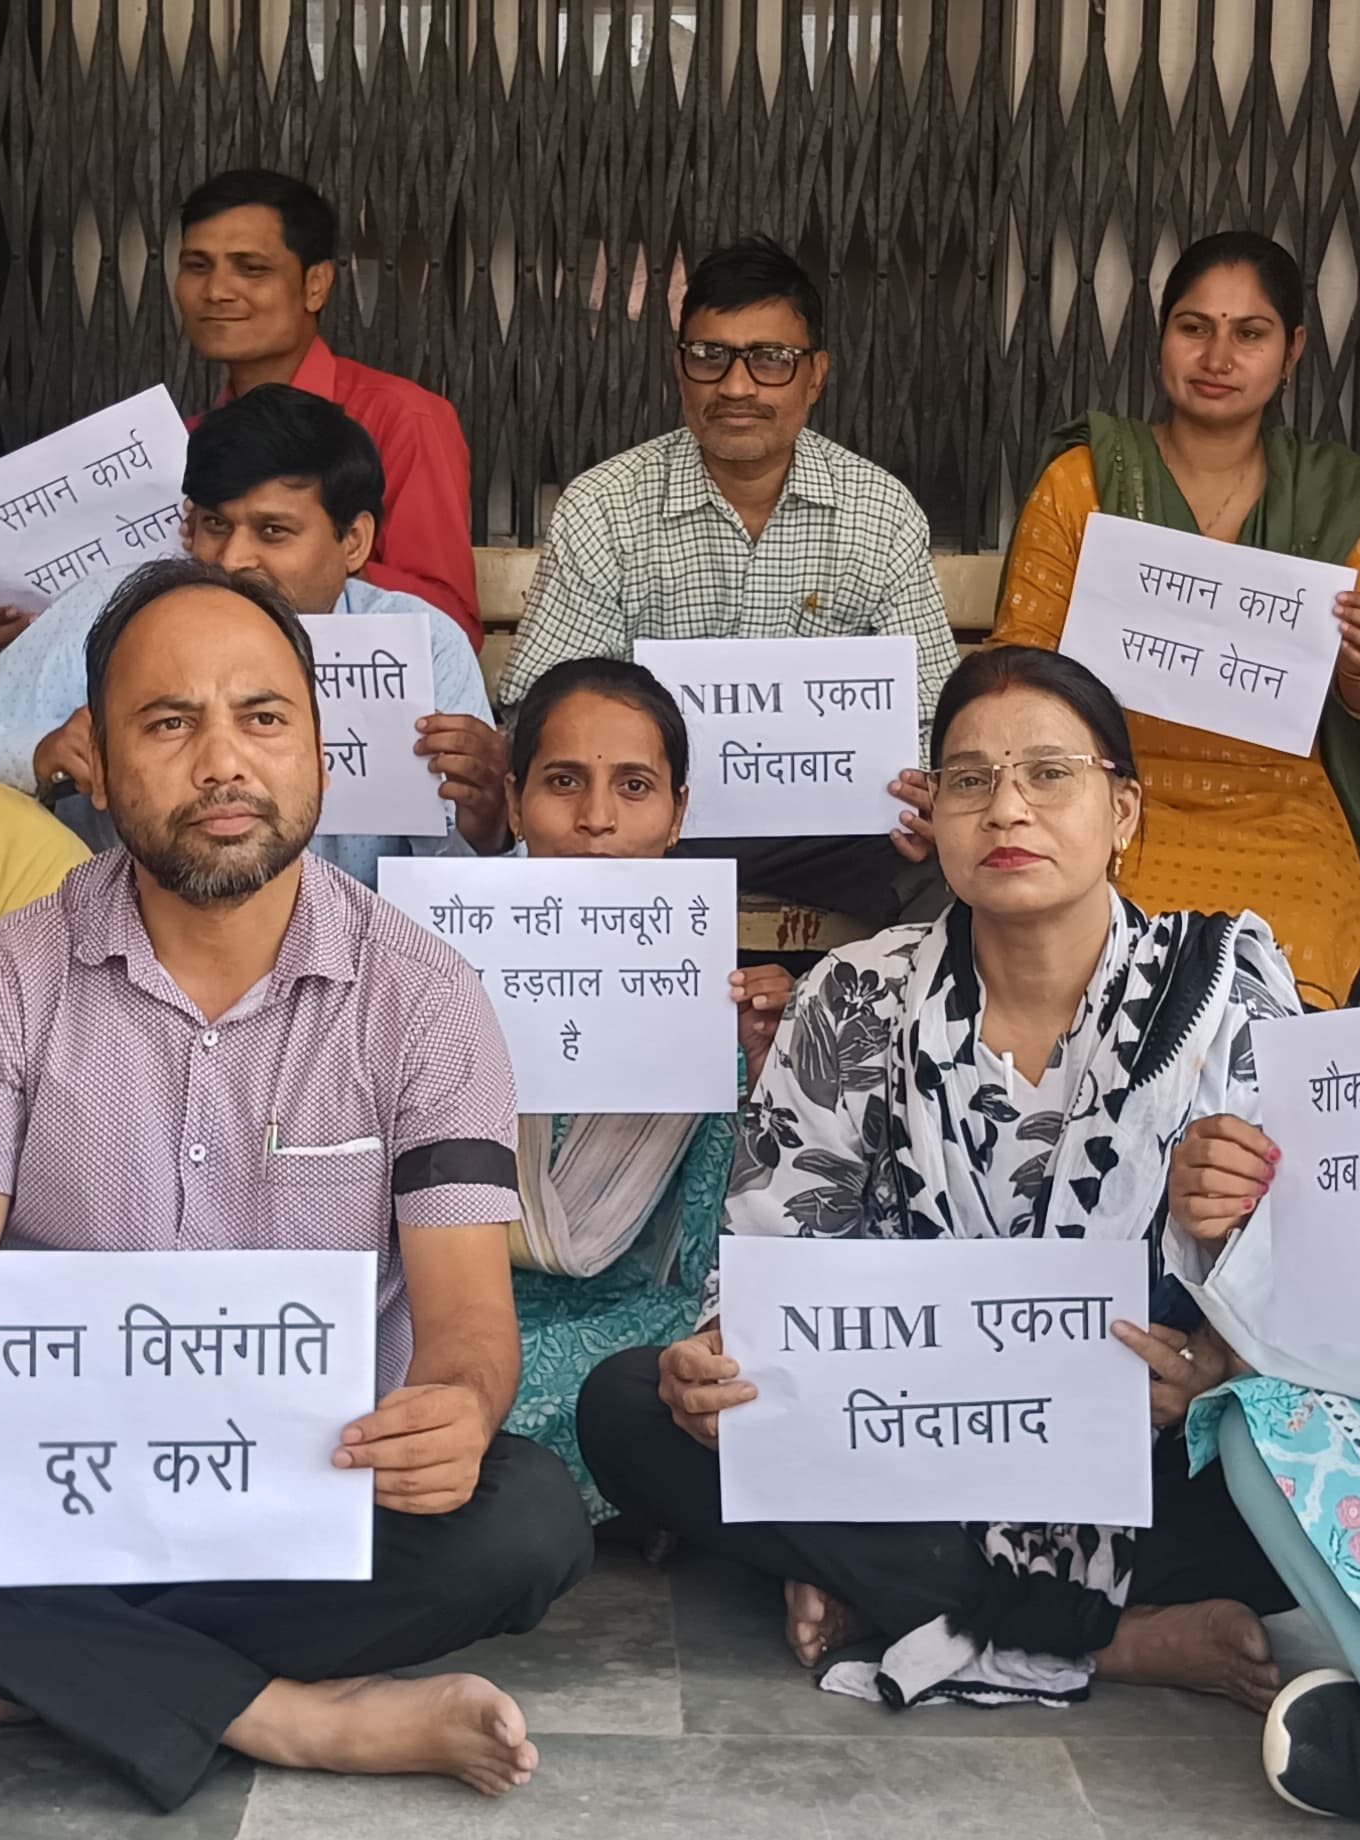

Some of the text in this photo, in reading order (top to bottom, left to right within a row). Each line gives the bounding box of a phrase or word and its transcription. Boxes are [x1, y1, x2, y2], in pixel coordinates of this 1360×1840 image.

[83, 428, 153, 488] कार्य
[23, 503, 185, 595] समान वेतन
[1138, 562, 1308, 631] समान कार्य
[1121, 628, 1289, 700] समान वेतन
[678, 677, 896, 718] NHM एकता
[717, 739, 857, 786] जिंदाबाद
[428, 894, 711, 947] शौक नहीं मजबूरी है
[500, 967, 604, 1004] हड़ताल
[617, 957, 702, 999] जरूरी
[559, 1018, 583, 1063] है
[1315, 1153, 1360, 1195] अब
[117, 1300, 336, 1378] विसंगति
[778, 1295, 1115, 1354] NHM एकता
[841, 1387, 1054, 1451] जिंदाबाद
[37, 1417, 258, 1517] दूर करो
